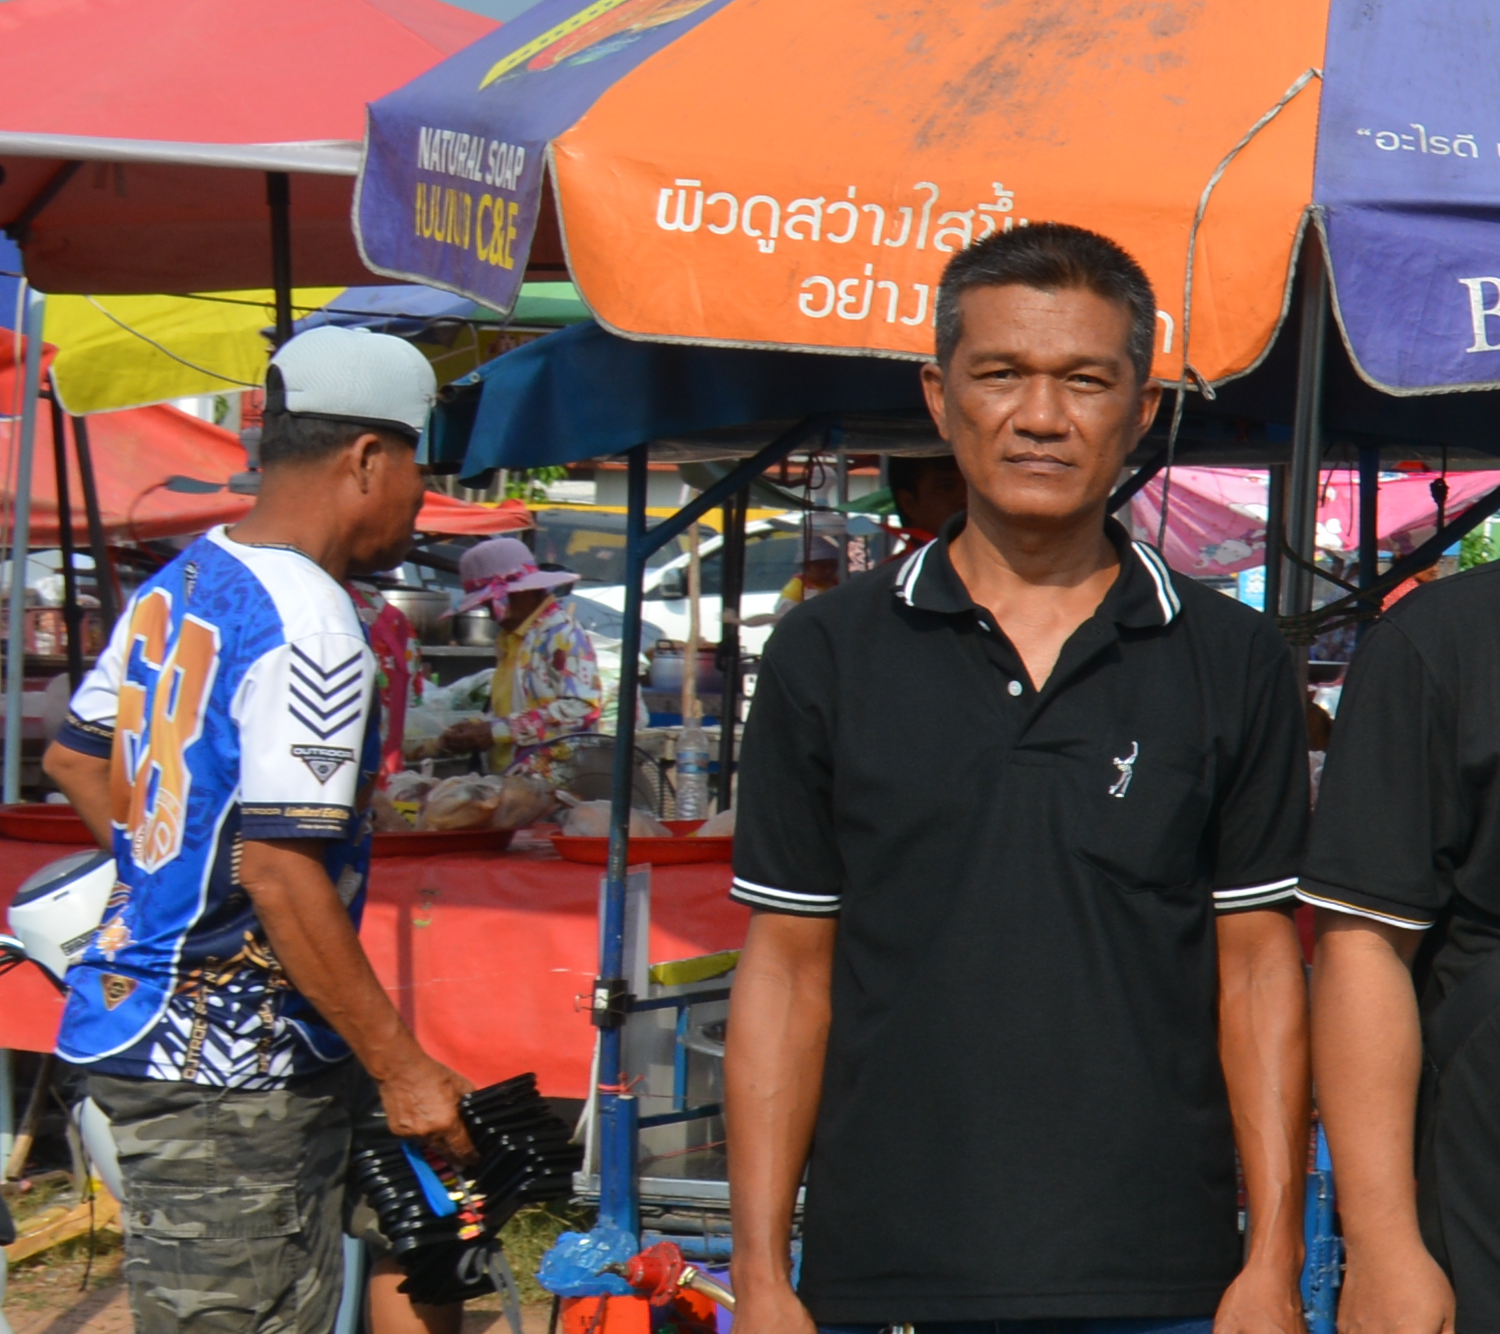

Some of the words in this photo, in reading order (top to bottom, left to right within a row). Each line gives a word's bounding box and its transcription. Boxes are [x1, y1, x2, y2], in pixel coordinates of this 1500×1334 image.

[418, 126, 485, 182] NATURAL
[485, 140, 525, 191] SOAP
[798, 263, 937, 327] อย่าง
